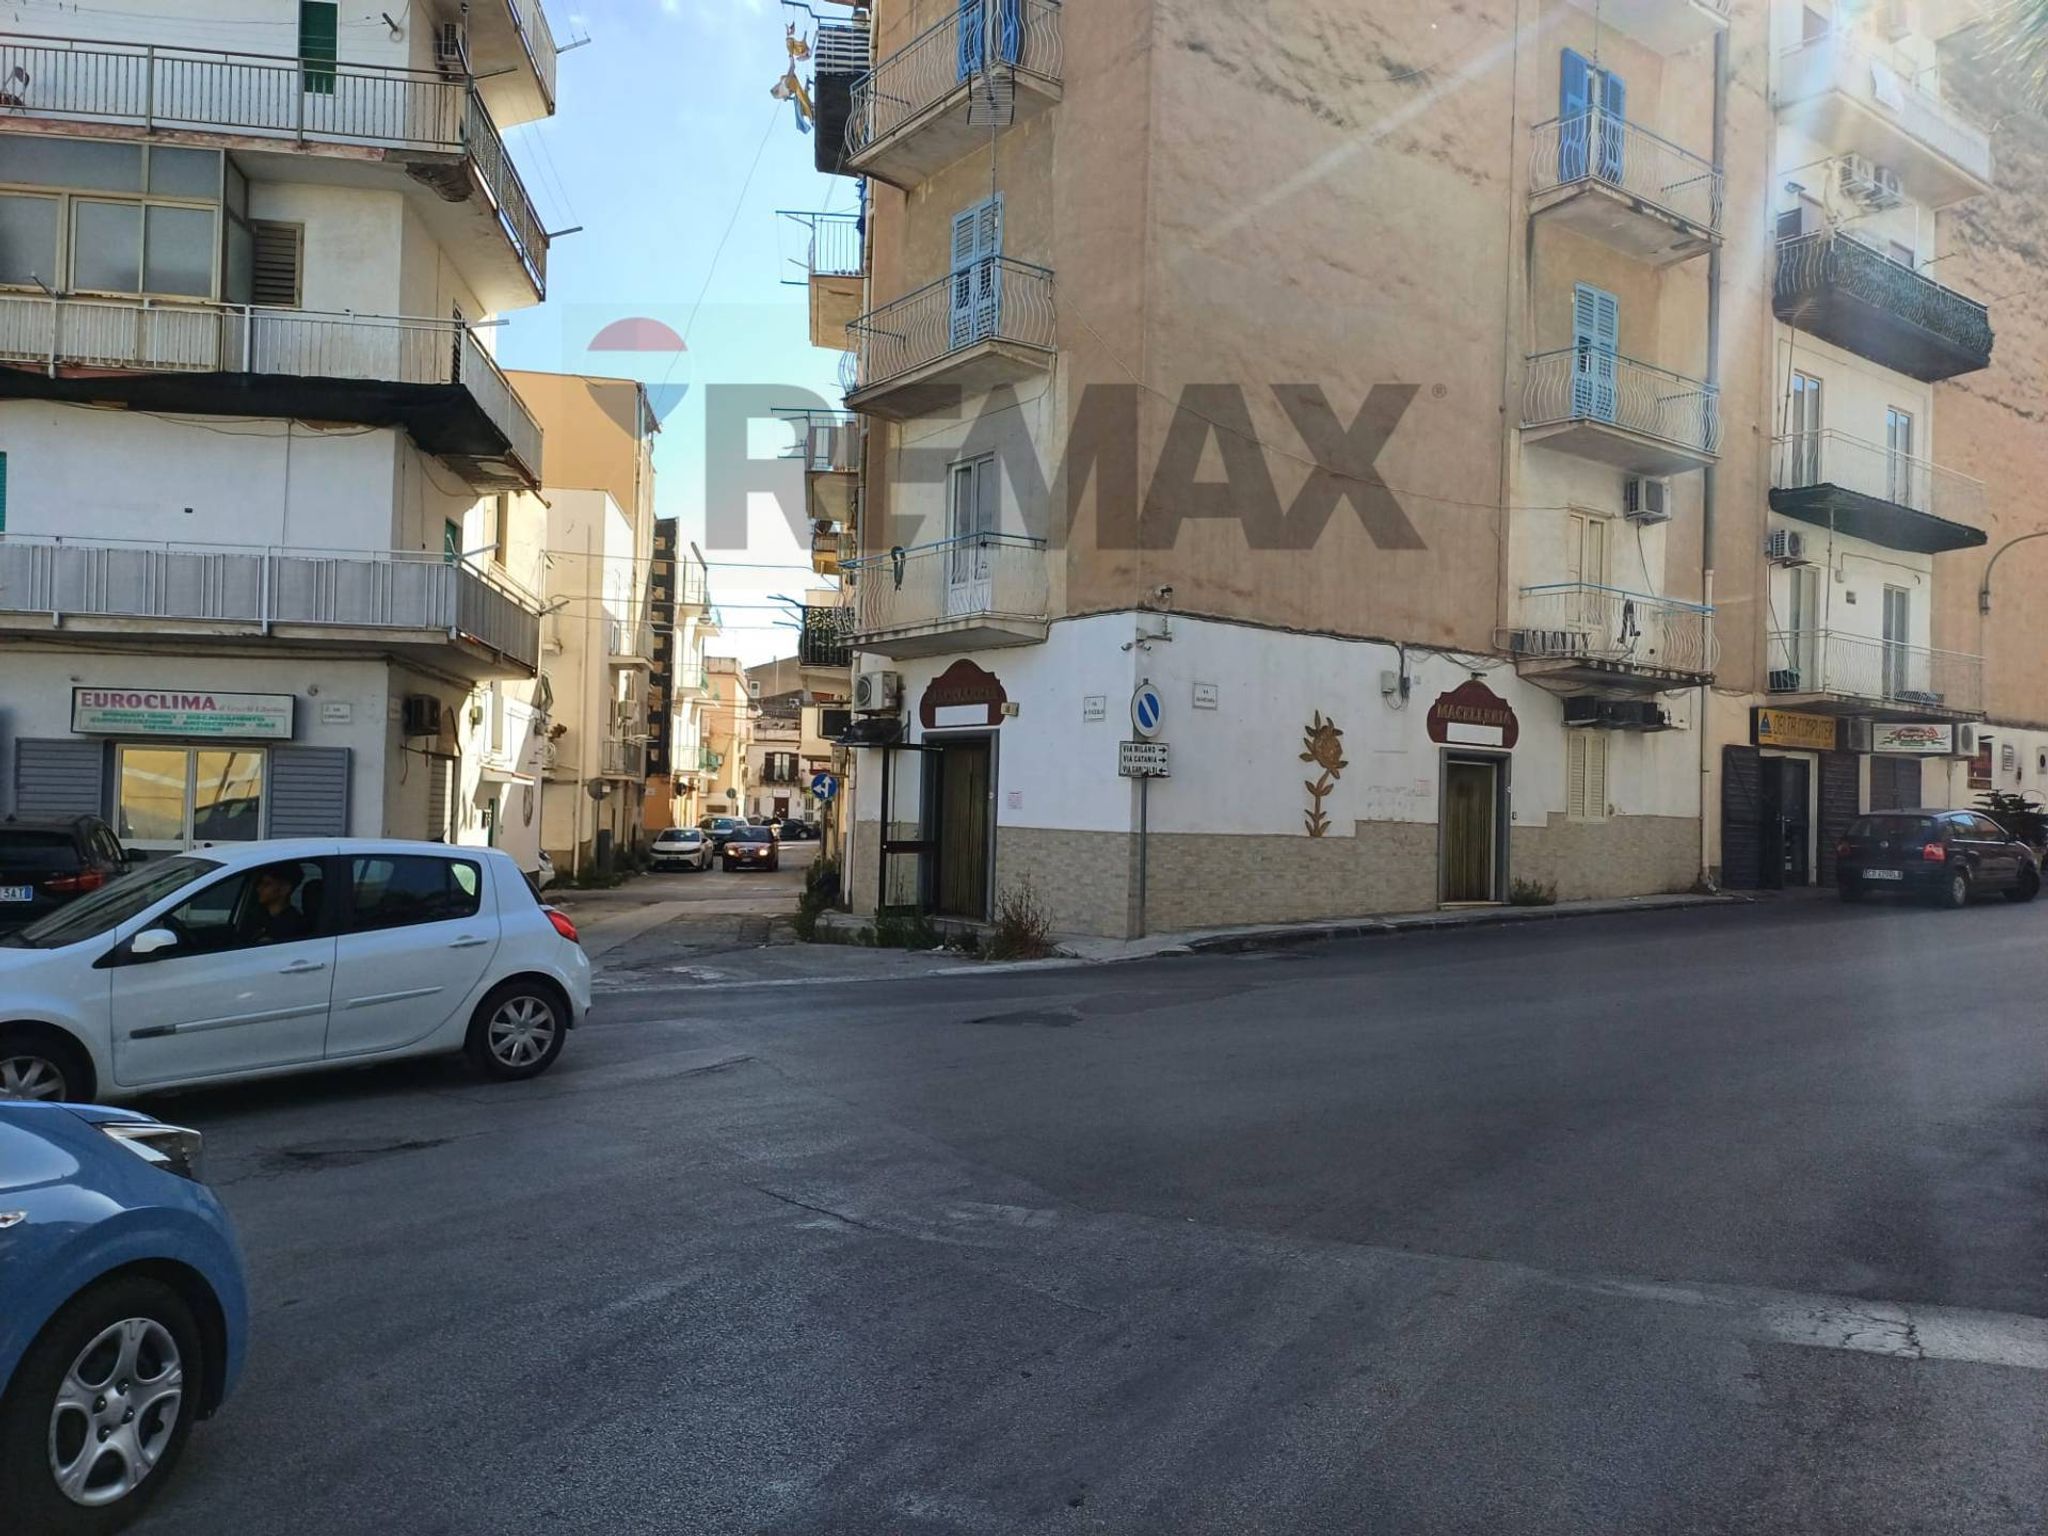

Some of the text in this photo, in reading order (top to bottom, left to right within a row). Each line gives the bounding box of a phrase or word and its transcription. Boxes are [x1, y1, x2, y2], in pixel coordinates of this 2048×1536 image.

[80, 692, 217, 712] EUROCLIMA
[1436, 703, 1511, 724] MACELLERIA
[1773, 713, 1834, 741] DELTA COMPUTER
[1123, 745, 1156, 754] VIA MILANO
[1123, 755, 1157, 763] VIA CATANIA
